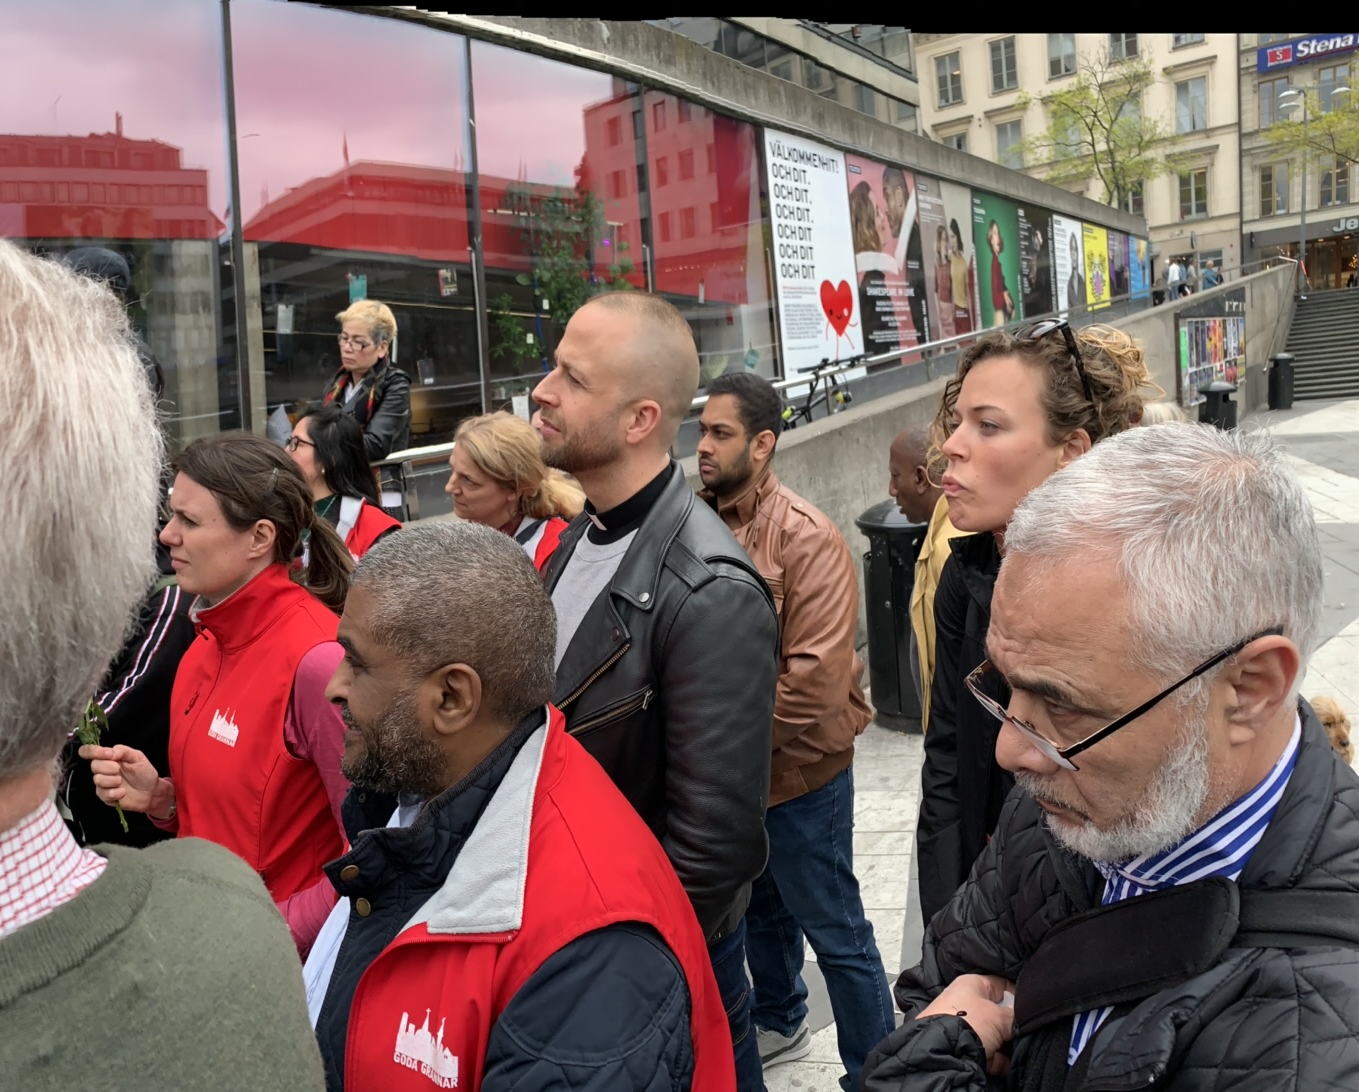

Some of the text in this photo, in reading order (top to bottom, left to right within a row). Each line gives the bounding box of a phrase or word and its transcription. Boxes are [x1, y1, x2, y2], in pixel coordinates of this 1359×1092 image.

[1296, 33, 1354, 57] Stena
[772, 162, 792, 182] OCH
[774, 183, 793, 200] OCH
[775, 203, 795, 221] OCH
[777, 223, 812, 242] OCH DIT
[1332, 218, 1359, 232] Je
[779, 243, 814, 261] OCH DIT
[781, 263, 815, 280] OCH DIT
[393, 1051, 458, 1089] GODA GRANNAR
